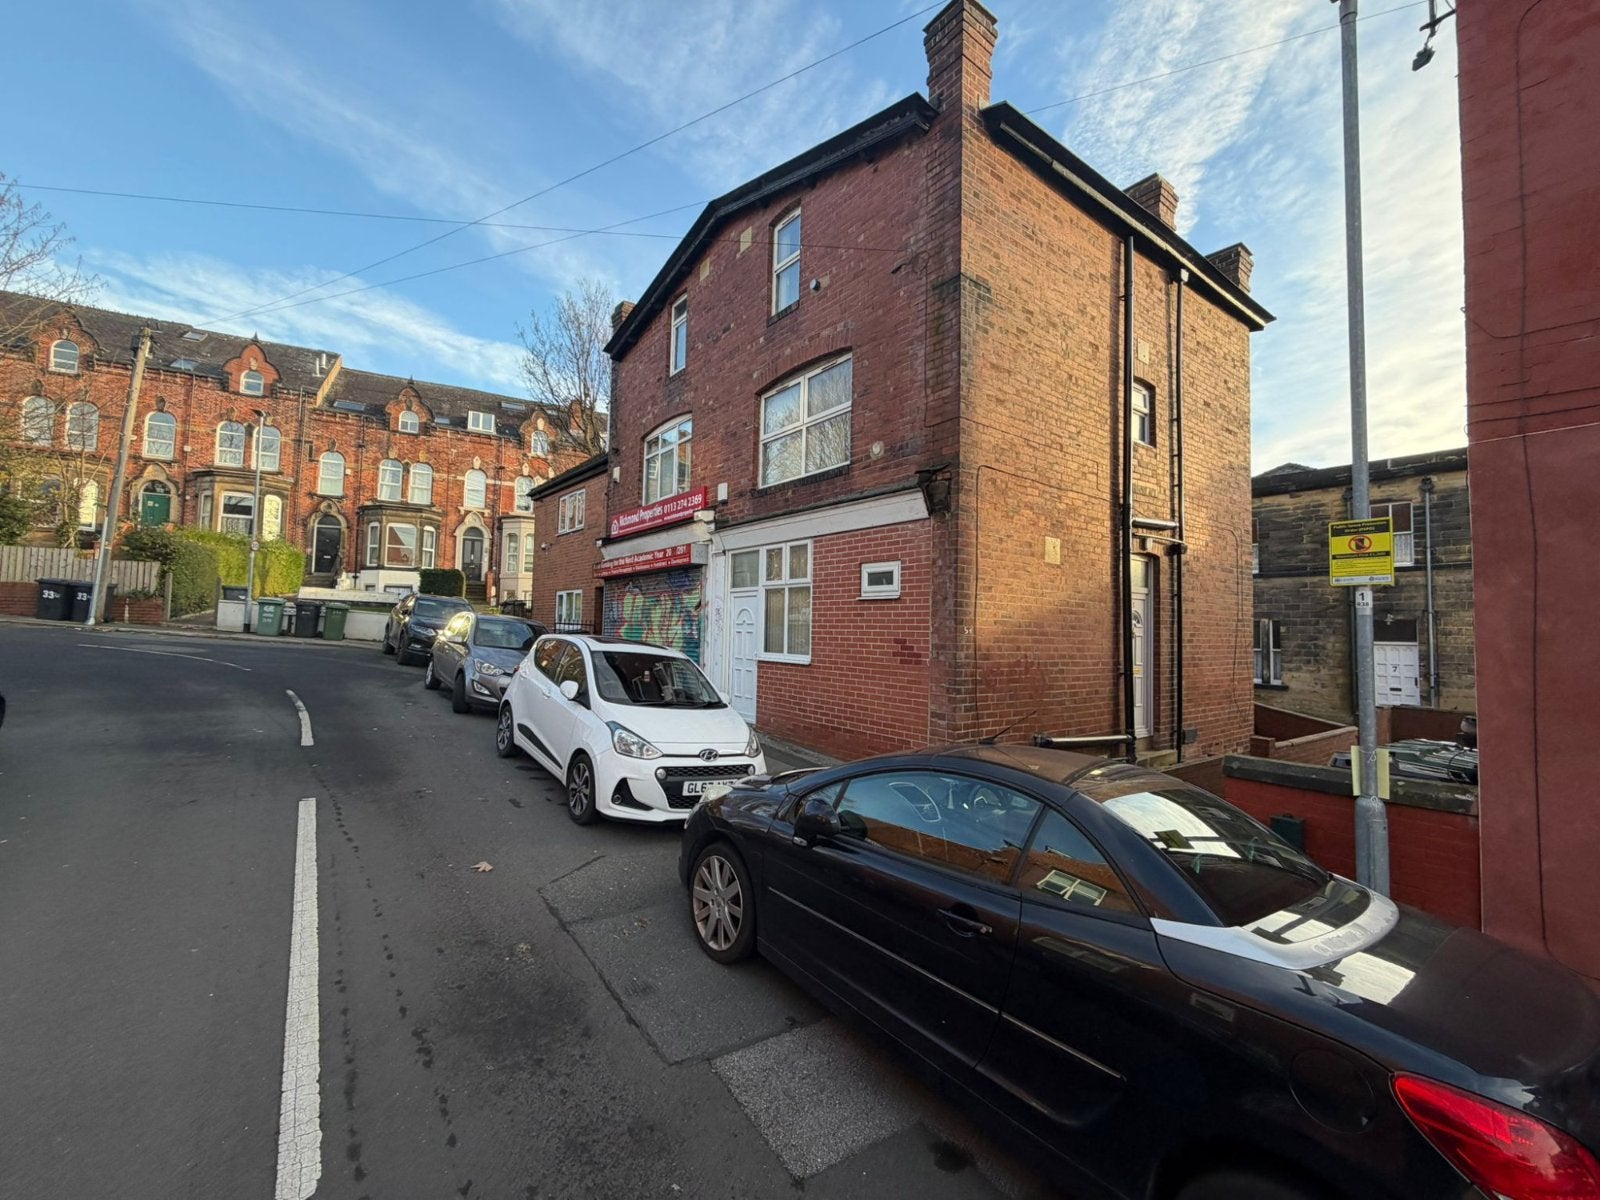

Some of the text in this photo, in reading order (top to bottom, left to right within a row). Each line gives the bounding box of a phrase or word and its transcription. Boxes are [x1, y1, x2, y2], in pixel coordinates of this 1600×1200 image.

[619, 510, 640, 526] Richmond
[640, 504, 663, 522] Properties
[664, 501, 676, 514] 0113
[677, 499, 687, 510] 274
[688, 494, 702, 507] 2369
[635, 552, 654, 562] Academic
[654, 550, 664, 560] Year
[42, 589, 55, 599] 33
[1359, 592, 1365, 601] 1
